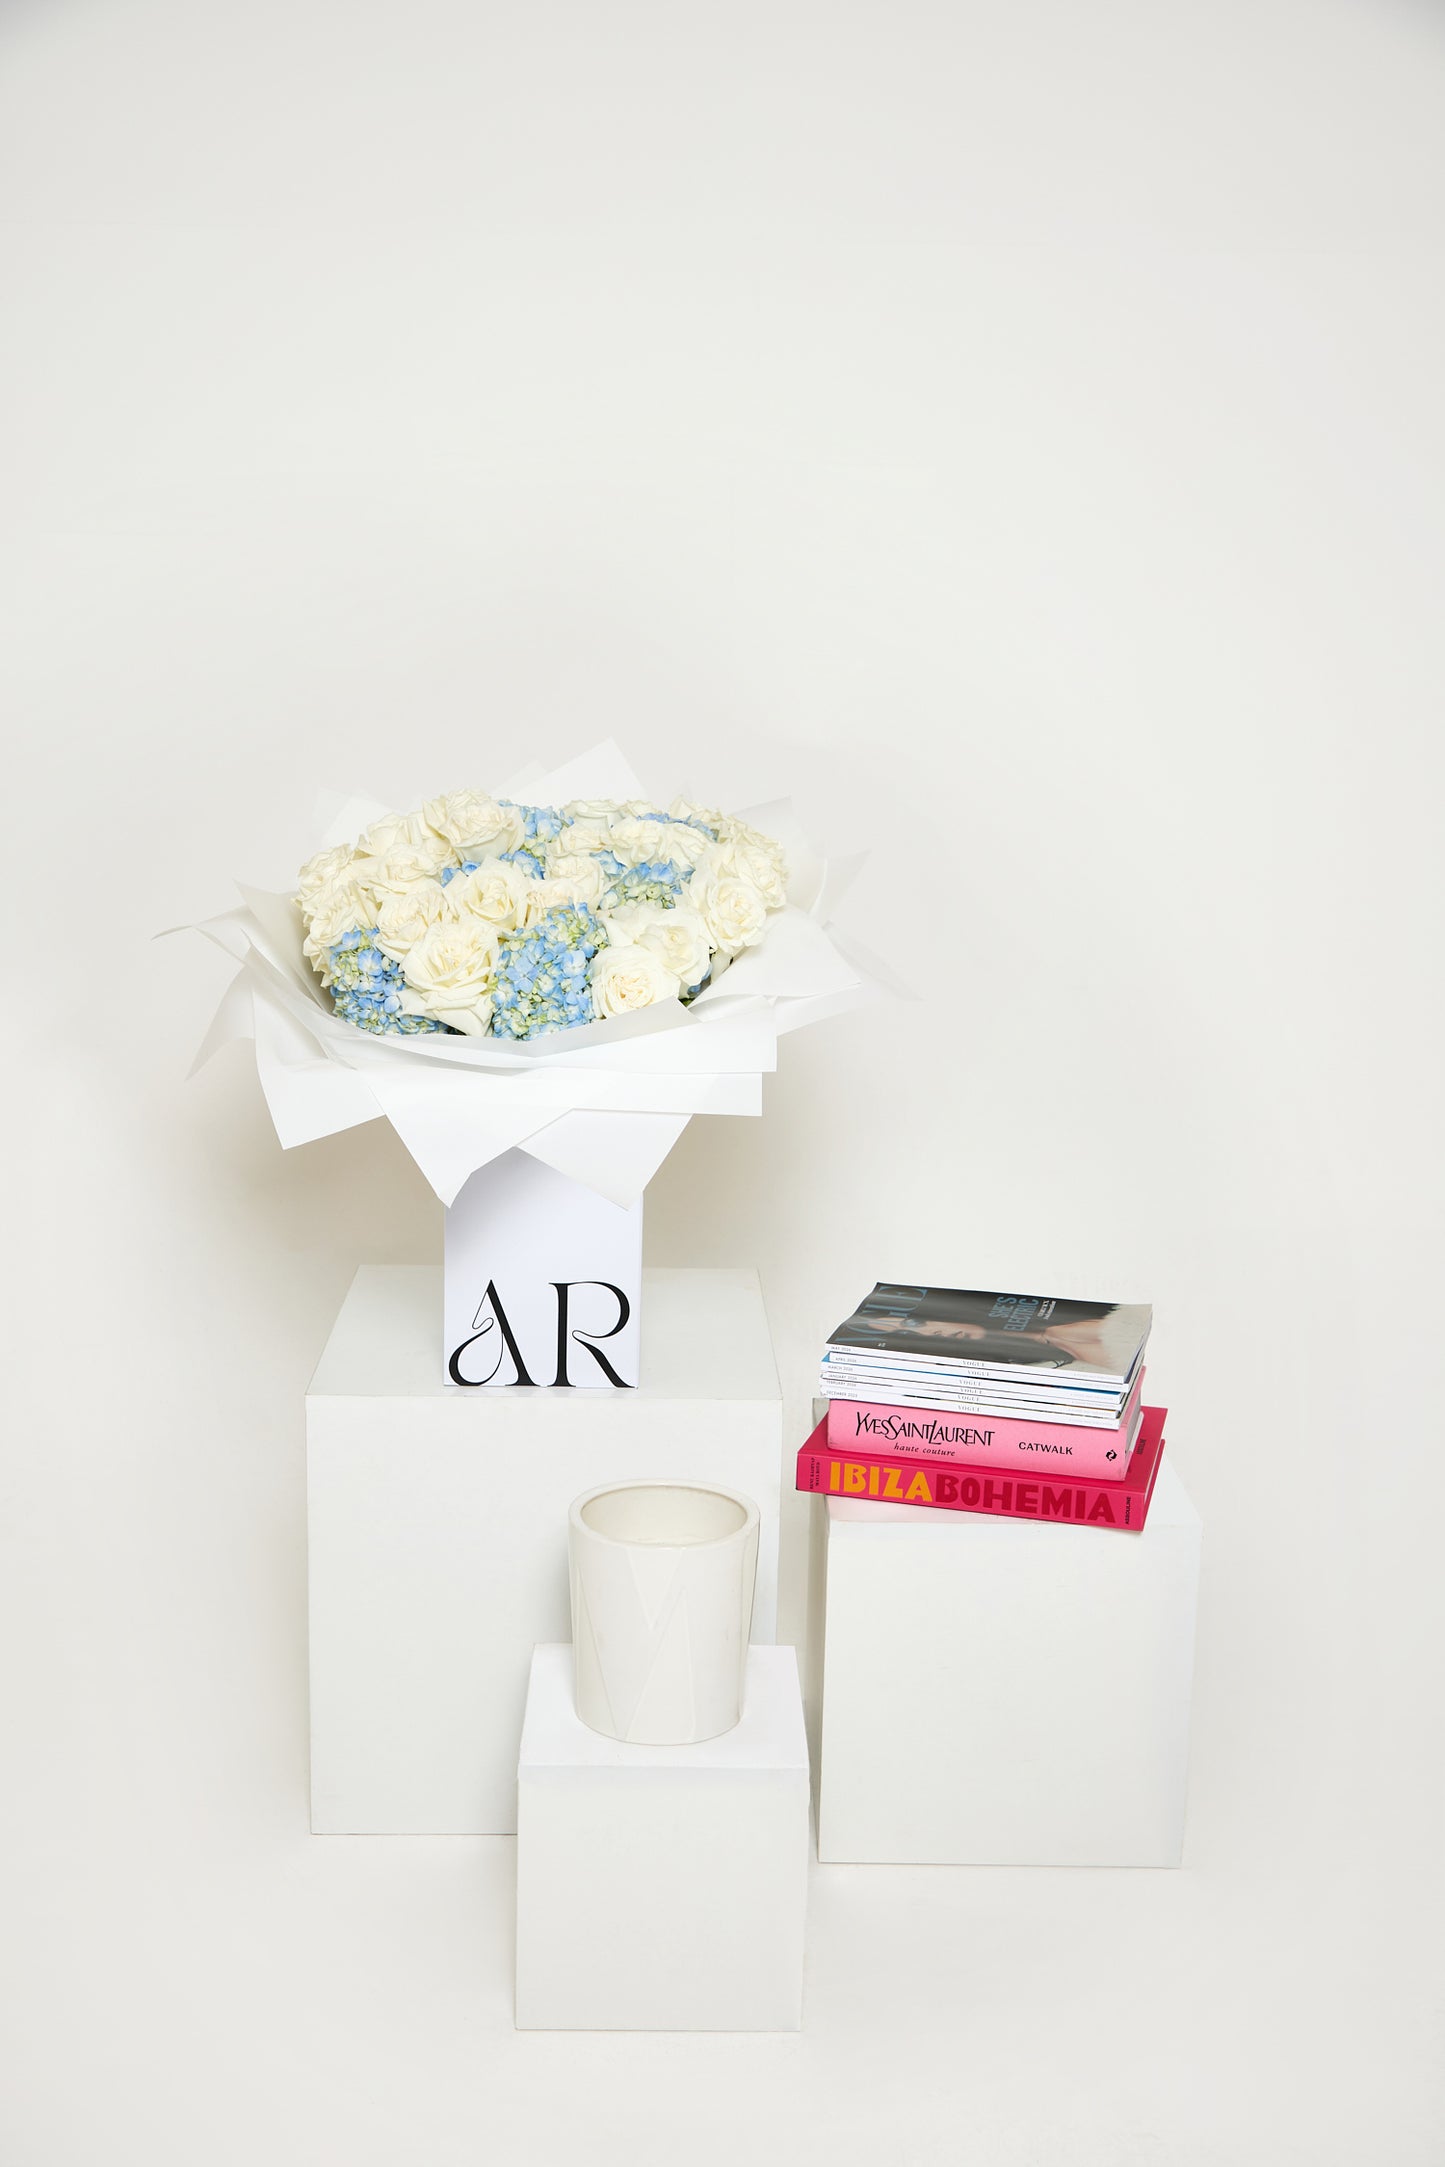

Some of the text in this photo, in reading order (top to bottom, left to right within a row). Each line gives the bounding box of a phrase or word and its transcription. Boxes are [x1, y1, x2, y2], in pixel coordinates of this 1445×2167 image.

[989, 1295, 1017, 1320] SHE'S
[1003, 1297, 1040, 1332] ELECTRIC
[448, 1278, 637, 1389] AR
[957, 1394, 979, 1402] VOGUE
[893, 1442, 956, 1457] haute couture
[1018, 1441, 1073, 1456] CATWALK
[829, 1461, 1116, 1524] IBIZA BOHEMIA
